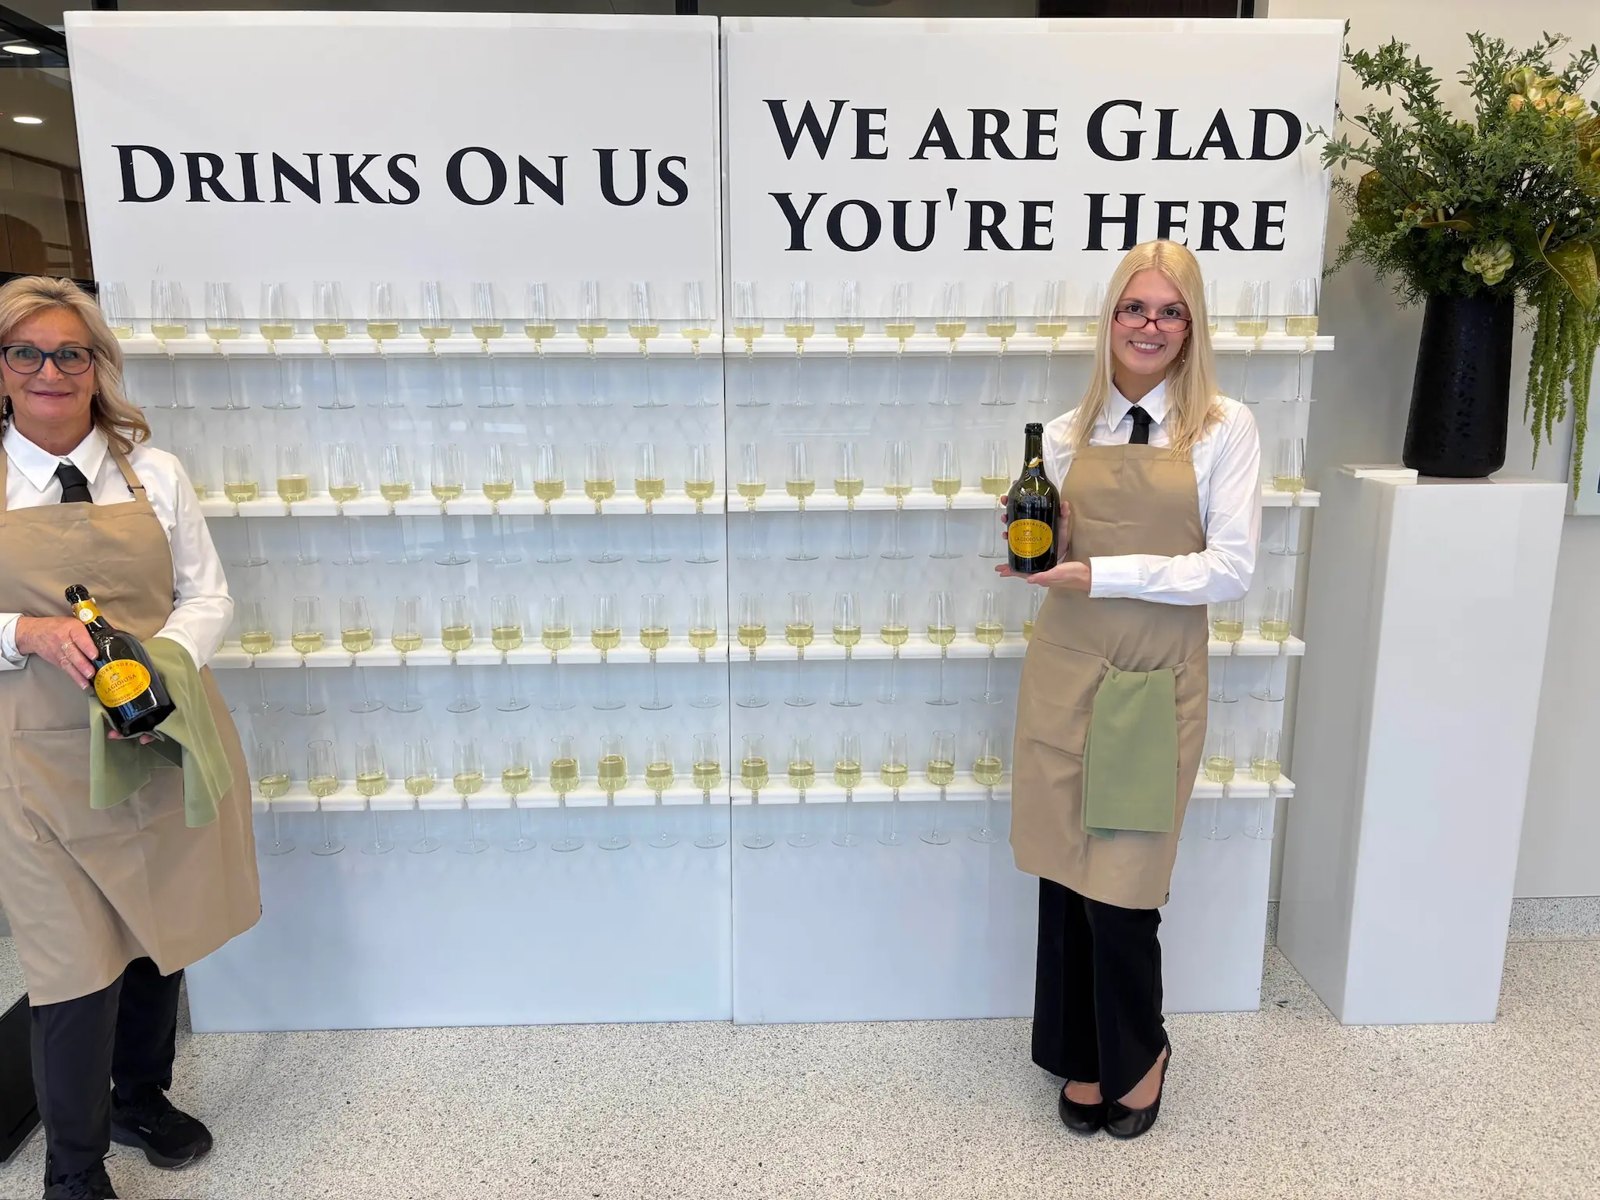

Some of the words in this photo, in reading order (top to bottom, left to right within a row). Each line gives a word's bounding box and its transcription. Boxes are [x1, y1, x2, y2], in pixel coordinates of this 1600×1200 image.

[762, 99, 889, 161] WE
[908, 108, 1059, 161] ARE
[1086, 99, 1302, 162] GLAD
[111, 144, 420, 205] DRINKS
[445, 146, 568, 207] ON
[592, 148, 689, 207] US
[767, 187, 1054, 252] YOU'RE
